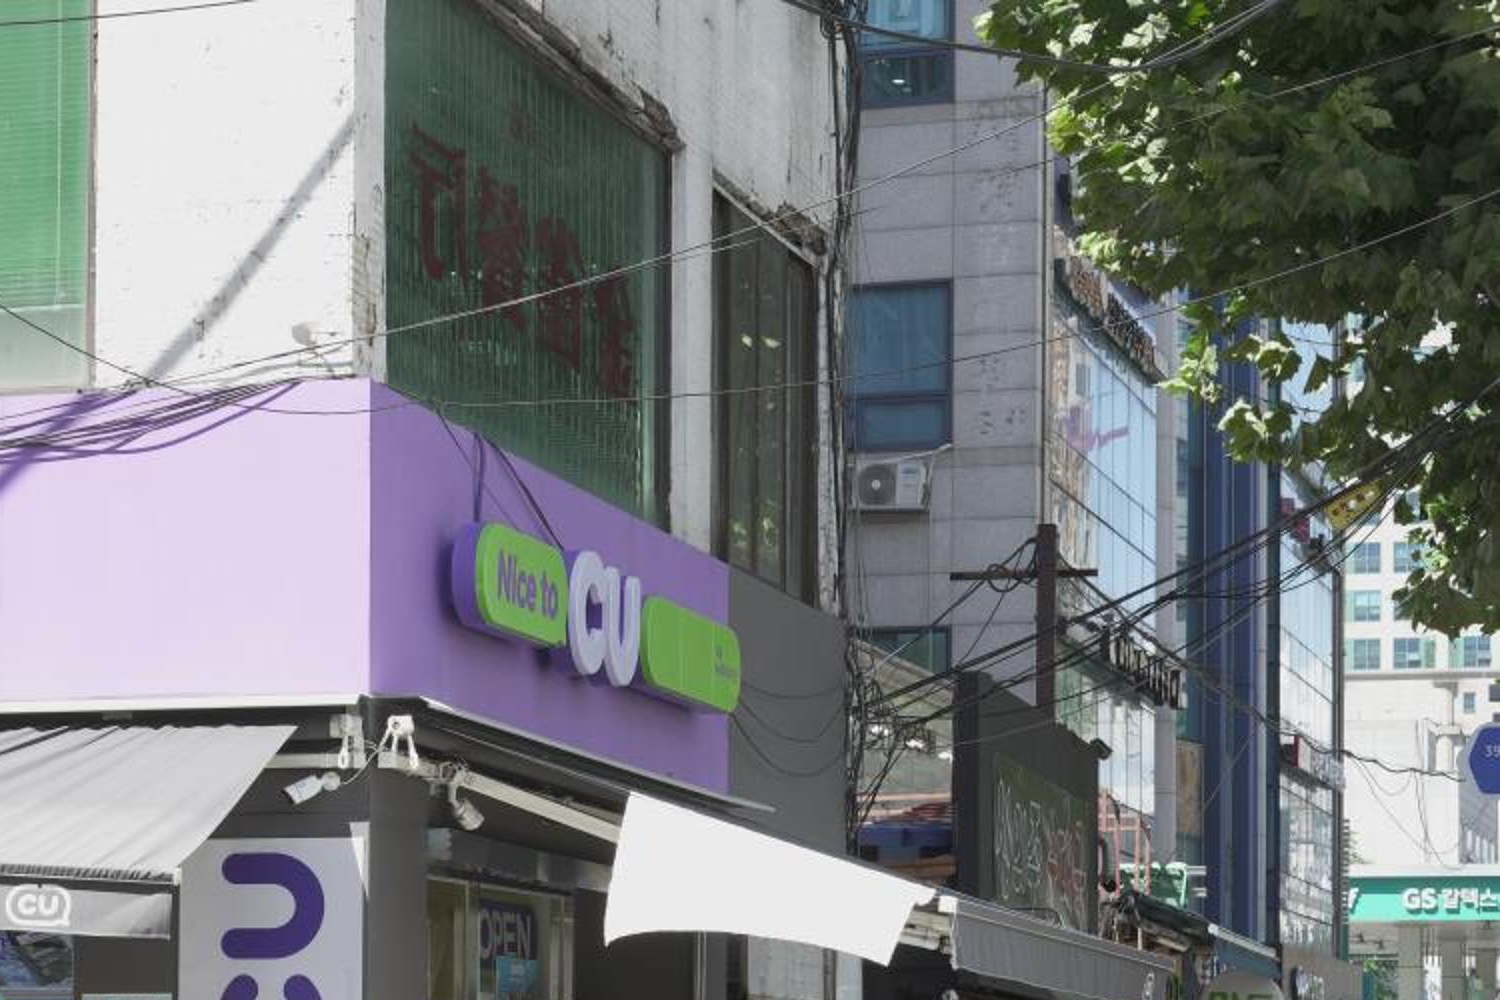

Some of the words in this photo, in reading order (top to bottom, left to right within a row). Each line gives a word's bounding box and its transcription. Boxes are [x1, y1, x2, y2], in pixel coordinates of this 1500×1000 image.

[496, 546, 536, 612] Nice
[541, 570, 559, 620] to
[568, 550, 642, 688] CU
[19, 893, 58, 916] CU
[1402, 886, 1438, 909] GS
[1442, 886, 1499, 911] 칼텍스
[478, 908, 532, 960] OPEN
